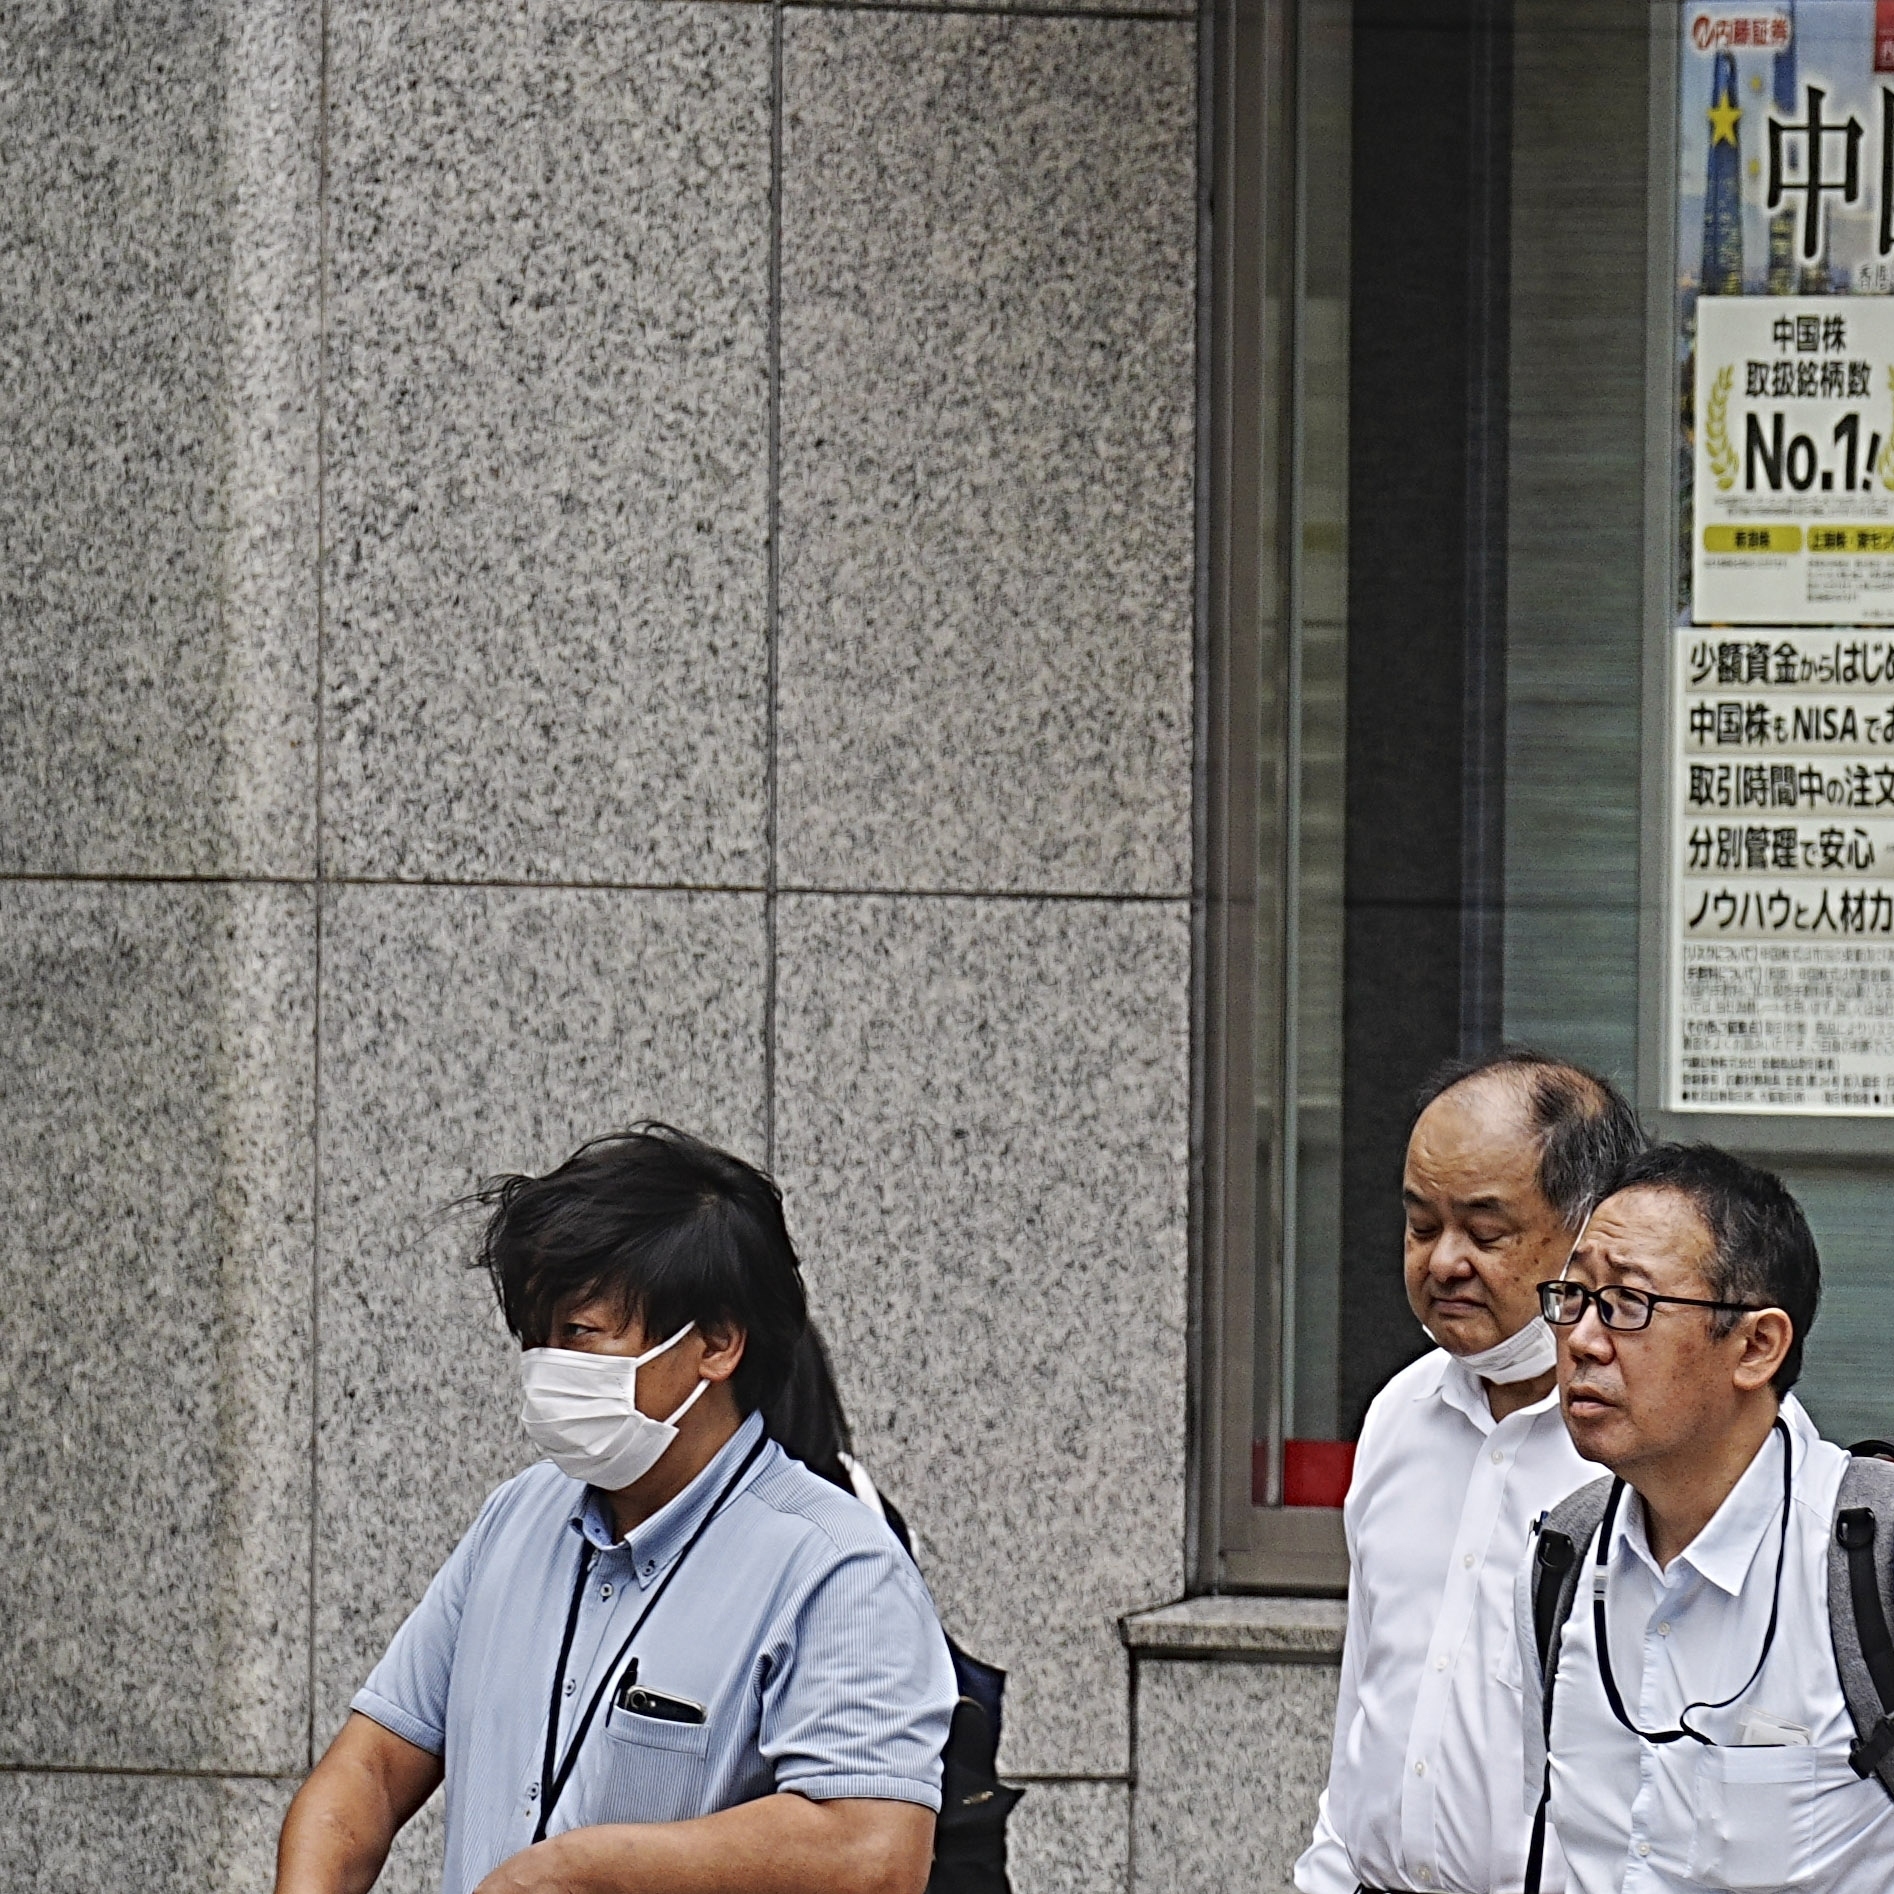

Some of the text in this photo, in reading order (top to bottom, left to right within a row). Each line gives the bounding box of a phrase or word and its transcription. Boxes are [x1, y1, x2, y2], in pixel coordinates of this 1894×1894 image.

[1772, 314, 1847, 353] 中国株
[1745, 360, 1871, 399] 取扱銘柄数
[1745, 412, 1881, 492] No.1!
[1688, 825, 1876, 871] 分別管理で安心
[1688, 888, 1894, 934] ノウハウと人材力
